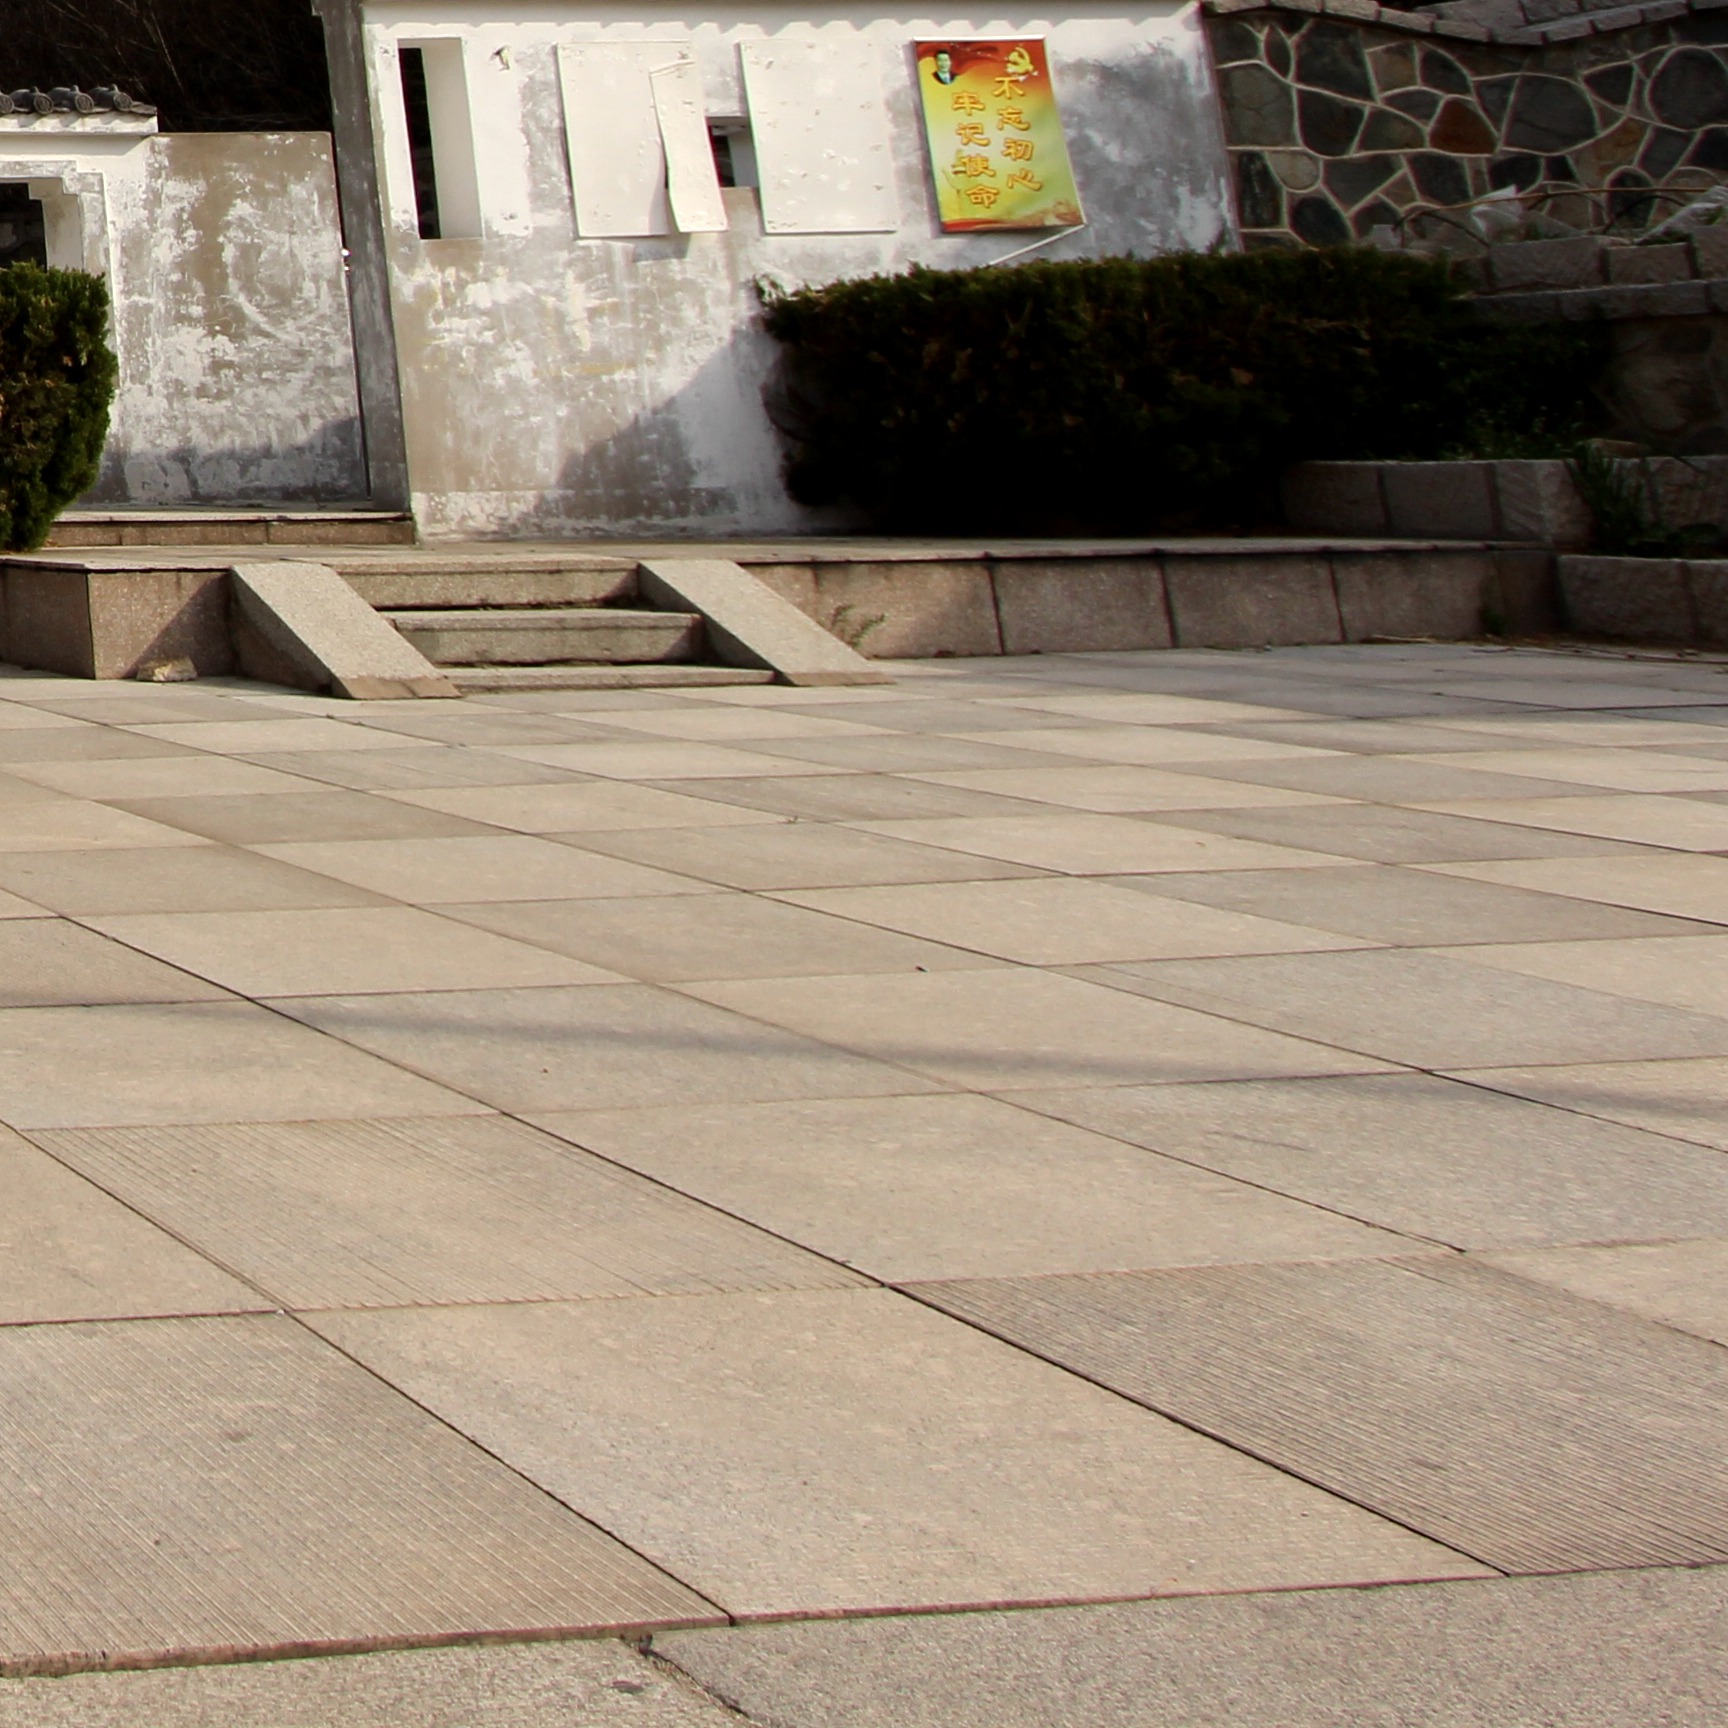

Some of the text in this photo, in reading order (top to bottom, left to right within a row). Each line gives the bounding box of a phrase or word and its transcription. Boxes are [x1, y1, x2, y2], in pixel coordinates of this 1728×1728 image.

[951, 90, 1001, 209] 牢记使命
[992, 75, 1044, 193] 不忘初心
